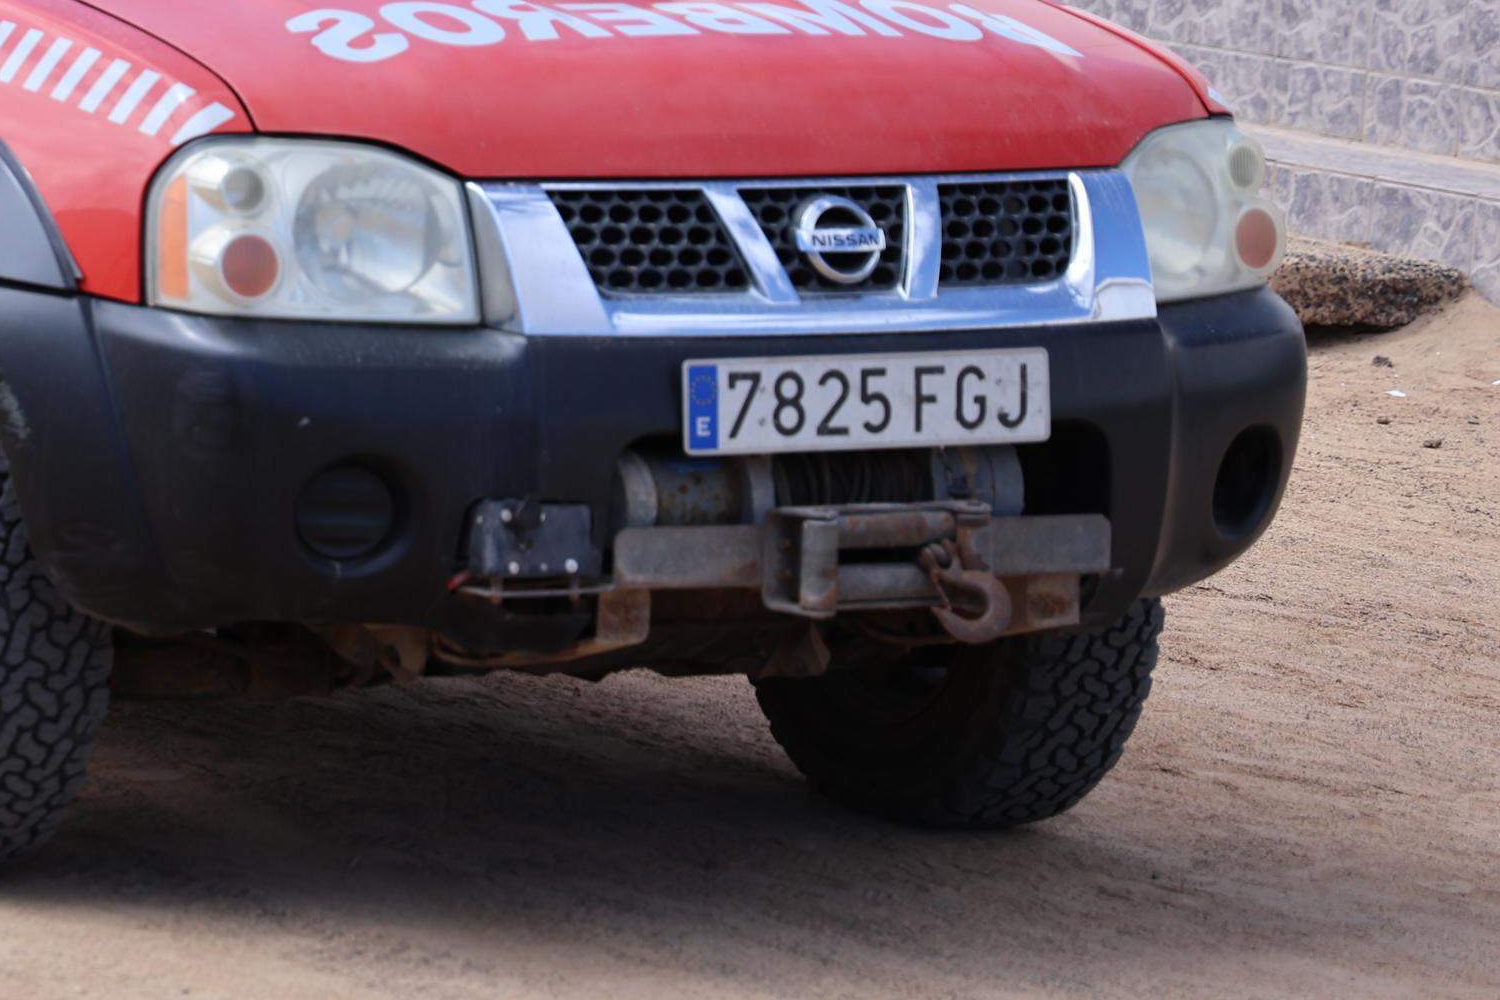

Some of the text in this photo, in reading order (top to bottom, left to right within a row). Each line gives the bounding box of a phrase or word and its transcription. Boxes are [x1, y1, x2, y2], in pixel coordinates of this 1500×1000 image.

[811, 233, 880, 247] NISSAN
[728, 363, 1028, 439] 7825 FGJ
[696, 416, 711, 437] E
